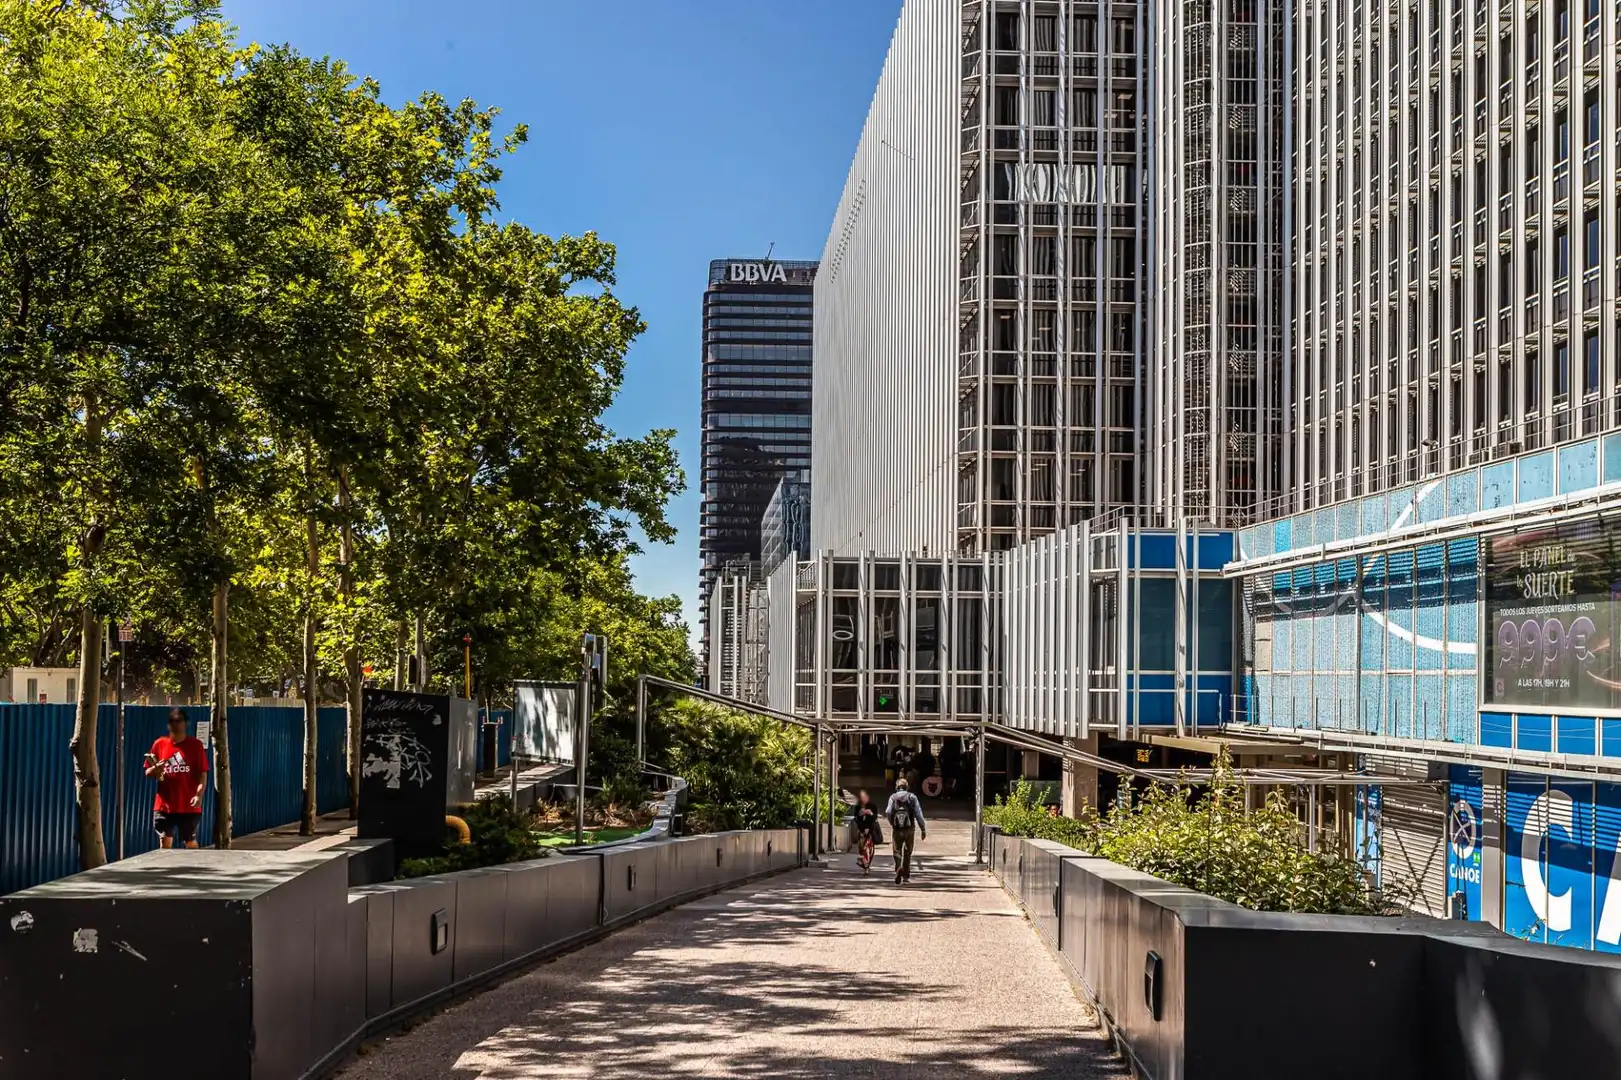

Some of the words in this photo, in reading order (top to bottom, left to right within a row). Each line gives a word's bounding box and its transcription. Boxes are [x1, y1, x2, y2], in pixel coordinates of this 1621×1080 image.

[730, 263, 787, 282] BBVA
[1520, 551, 1530, 568] EL
[1533, 545, 1566, 568] PANEL
[1524, 570, 1575, 600] SUERTE
[1500, 607, 1515, 617] TODOS
[1516, 607, 1525, 616] LOS
[1526, 605, 1544, 615] JUEVES
[1577, 602, 1596, 612] HASTA
[1517, 678, 1522, 687] A
[1450, 863, 1480, 884] CANOE
